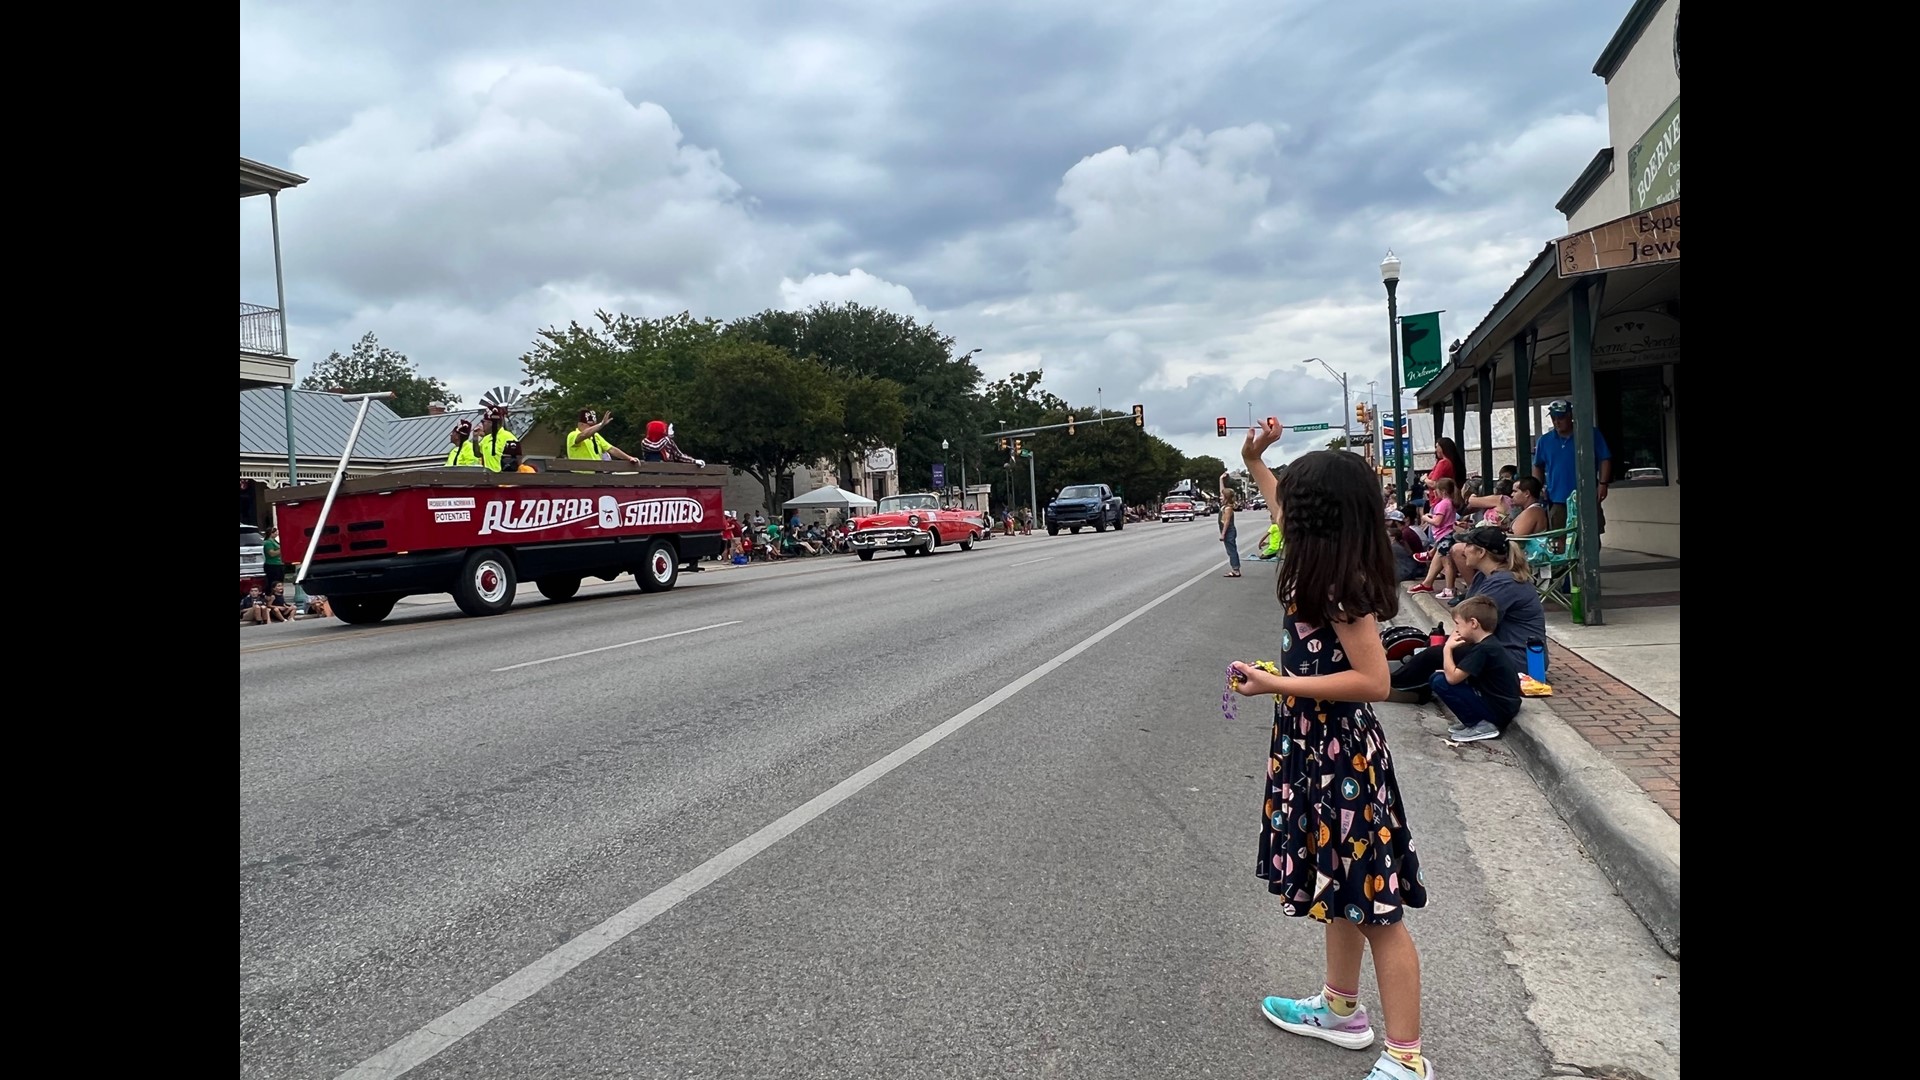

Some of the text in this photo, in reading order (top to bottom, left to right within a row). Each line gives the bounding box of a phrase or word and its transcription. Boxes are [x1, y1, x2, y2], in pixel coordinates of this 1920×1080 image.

[1637, 113, 1680, 208] BOERNE
[1639, 214, 1680, 233] Expe
[1407, 366, 1439, 381] Welcome
[436, 512, 470, 521] POTENTATE
[624, 497, 704, 527] SHRINER
[1299, 658, 1323, 676] #1
